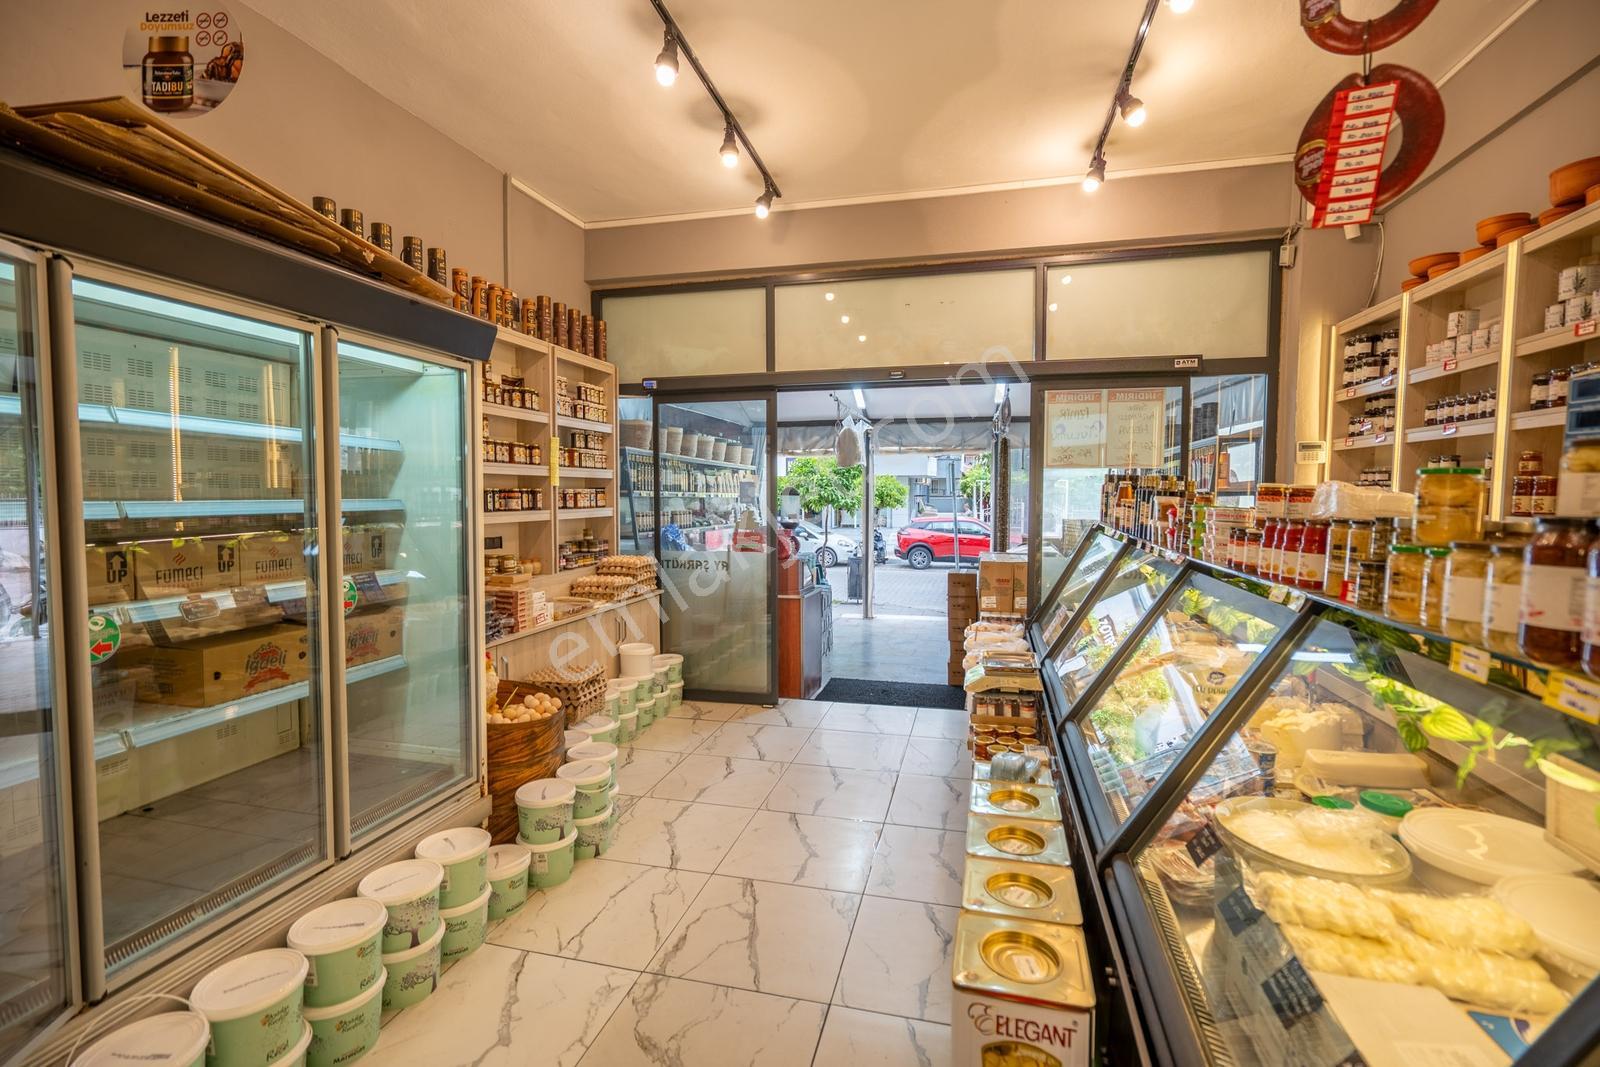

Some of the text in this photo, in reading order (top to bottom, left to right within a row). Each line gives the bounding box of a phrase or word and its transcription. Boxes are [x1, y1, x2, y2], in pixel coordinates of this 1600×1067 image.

[145, 10, 189, 22] Lezzeti
[140, 22, 195, 32] Doyumsuz
[371, 547, 382, 558] UP
[217, 560, 234, 573] UP
[106, 568, 128, 584] UP
[995, 1015, 1079, 1049] ELEGANT
